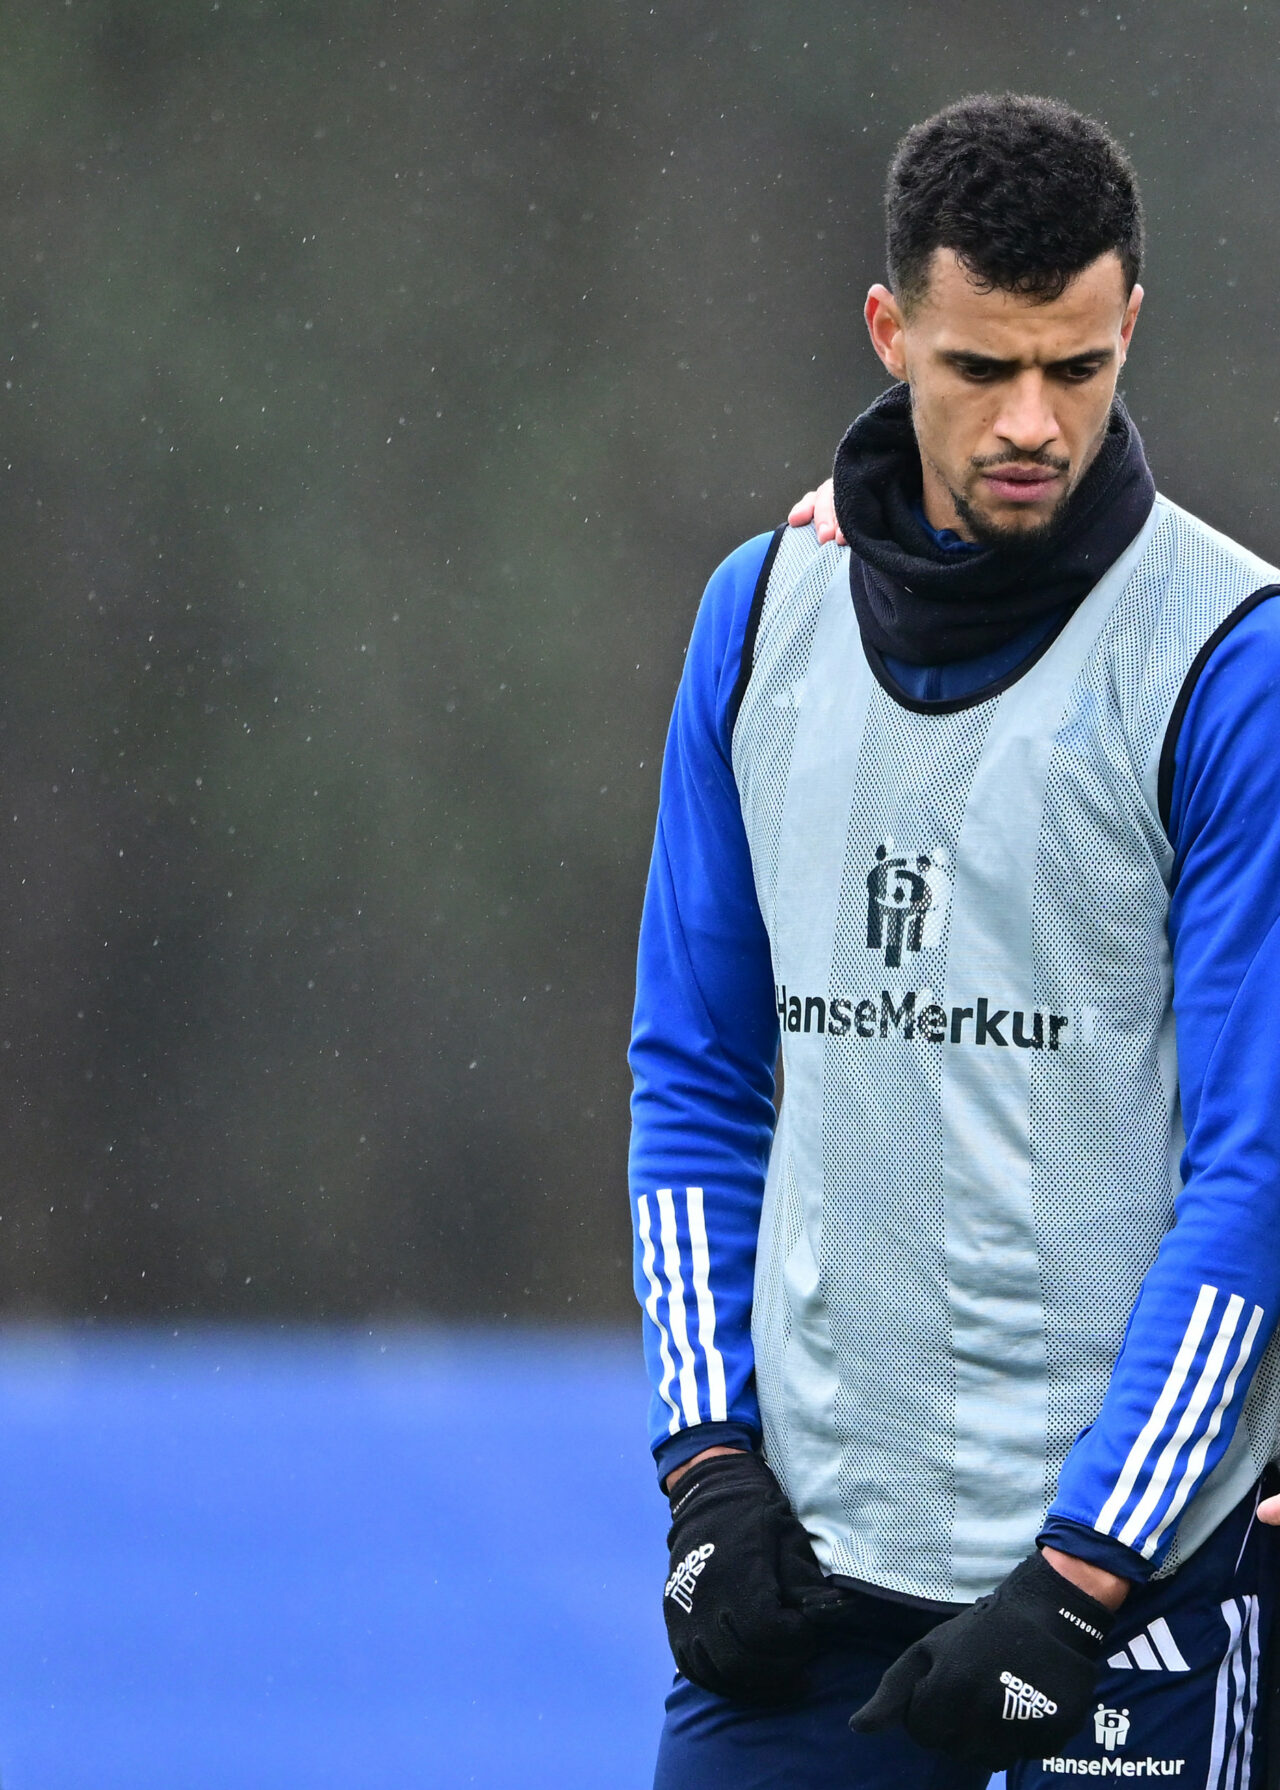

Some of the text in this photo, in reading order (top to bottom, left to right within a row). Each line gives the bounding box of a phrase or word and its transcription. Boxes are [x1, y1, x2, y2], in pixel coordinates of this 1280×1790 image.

[775, 984, 1069, 1051] HanseMerkur
[1000, 1671, 1058, 1716] adidas
[1042, 1756, 1186, 1777] HanseMerkur
